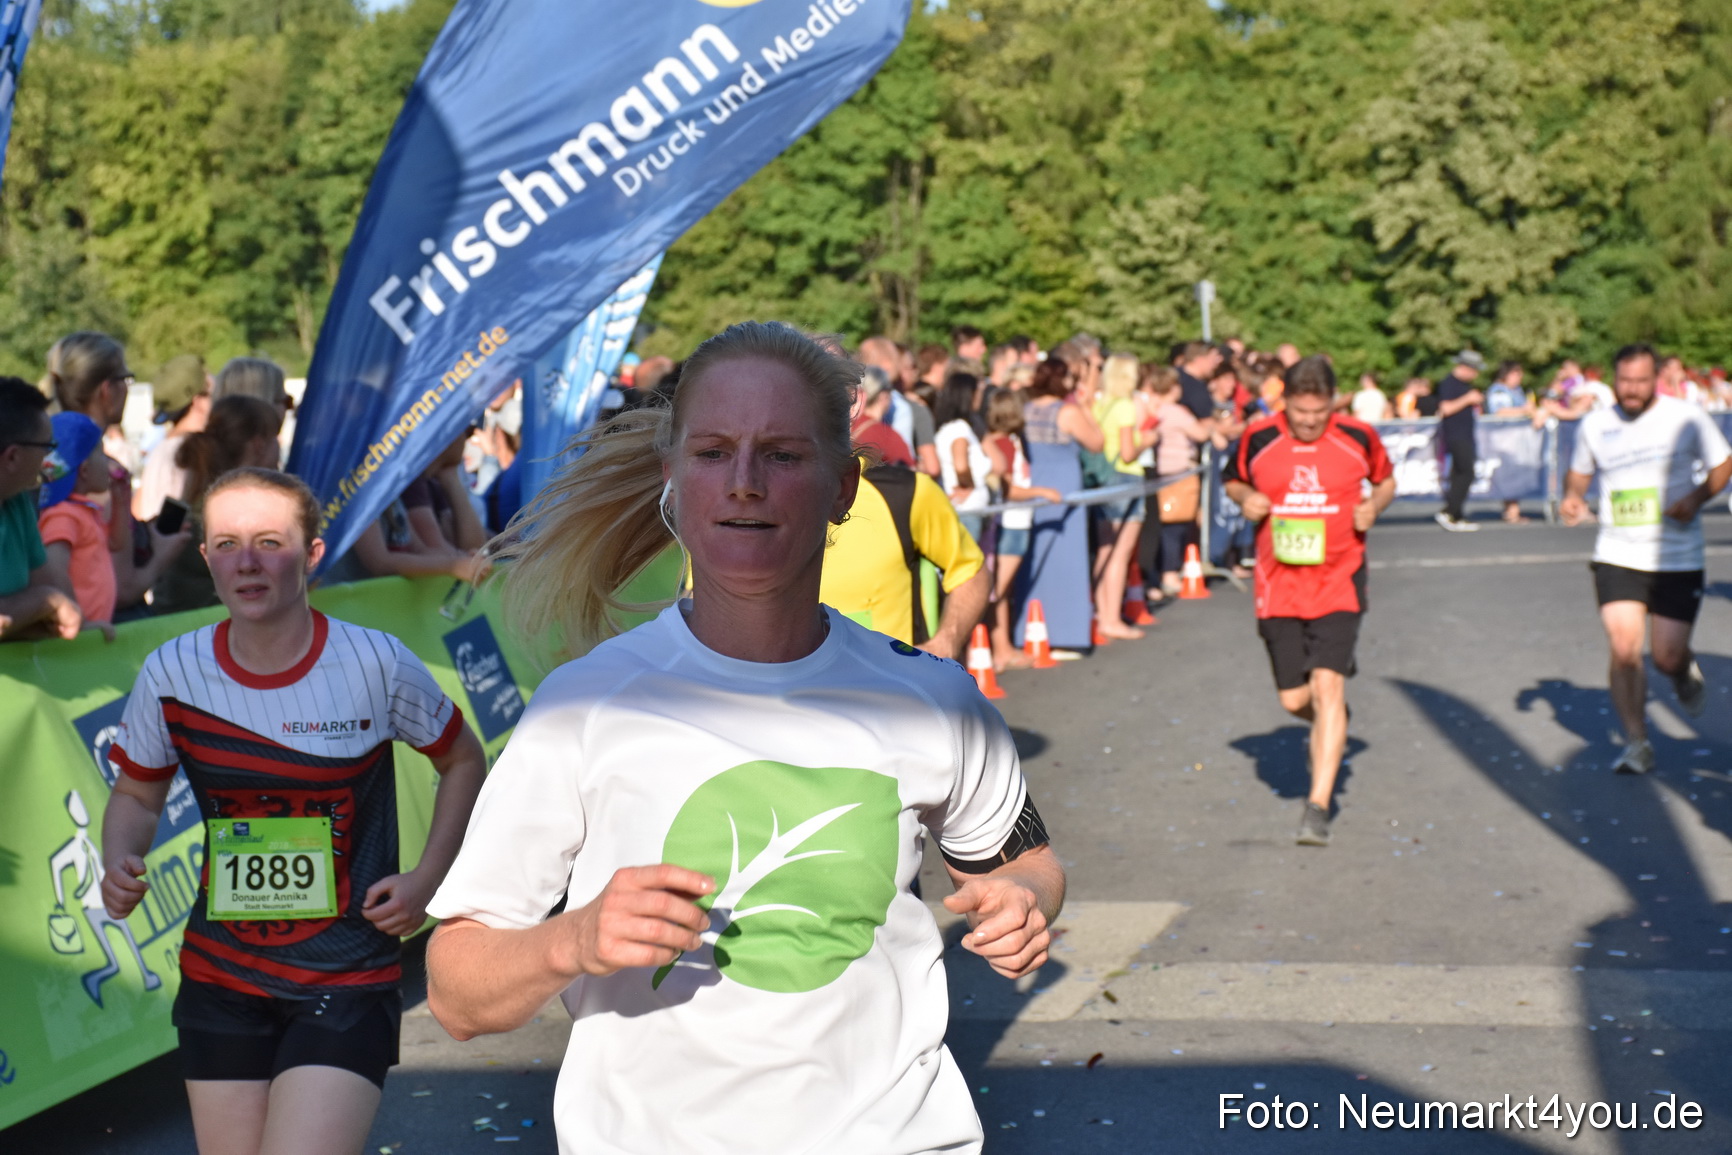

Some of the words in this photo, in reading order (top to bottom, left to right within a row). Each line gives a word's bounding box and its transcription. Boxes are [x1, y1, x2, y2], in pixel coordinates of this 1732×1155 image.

[612, 119, 706, 197] Druck
[703, 61, 767, 125] und
[761, 0, 866, 74] Medie
[369, 23, 741, 345] Frischmann
[282, 720, 357, 734] NEUMARKT
[225, 854, 315, 891] 1889
[231, 892, 270, 902] Donauer
[273, 891, 308, 901] Annika
[262, 902, 294, 910] Neumarkt
